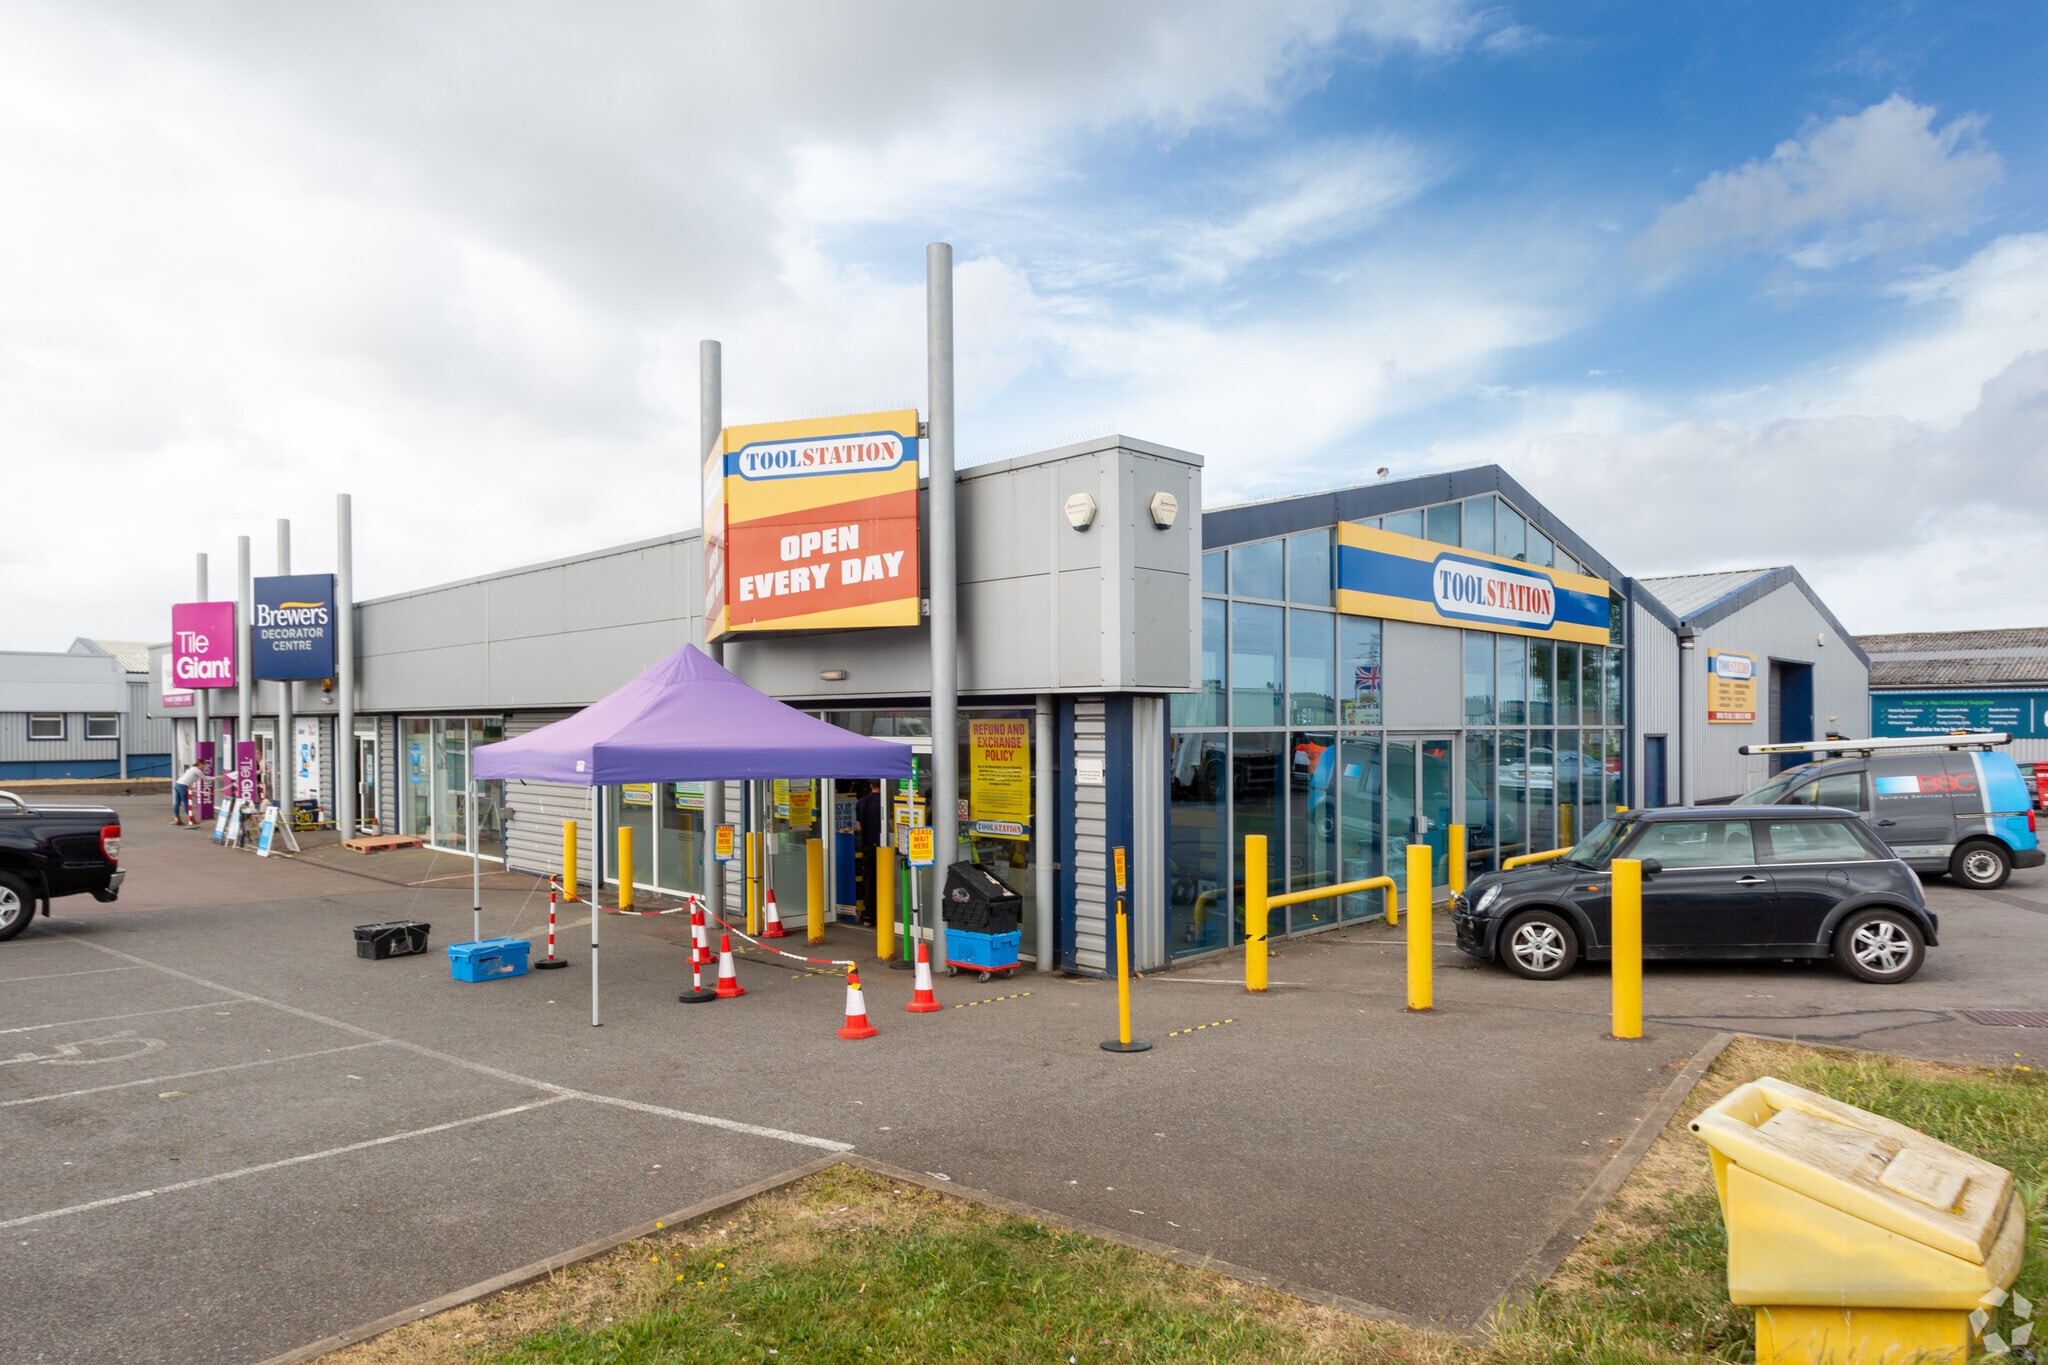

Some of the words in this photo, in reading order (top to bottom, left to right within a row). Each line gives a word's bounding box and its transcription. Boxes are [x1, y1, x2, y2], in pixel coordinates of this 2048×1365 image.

[746, 441, 896, 471] TOOLSTATION
[780, 523, 859, 562] OPEN
[739, 562, 831, 602] EVERY
[841, 550, 905, 586] DAY
[1439, 569, 1551, 616] TOOLSTATION
[256, 604, 329, 627] Brewers
[176, 631, 209, 654] Tile
[261, 627, 324, 639] DECORATOR
[272, 640, 312, 651] CENTRE
[176, 656, 231, 679] Giant
[1718, 659, 1750, 675] TOOLSTATION
[973, 723, 1005, 736] REFUND
[1008, 723, 1025, 736] AND
[977, 736, 1022, 749] EXCHANGE
[985, 749, 1014, 762] POLICY
[240, 758, 253, 778] Tile
[241, 779, 254, 801] Gia
[1916, 773, 1976, 793] BSC
[910, 828, 932, 836] PLEASE
[978, 823, 1021, 833] TOOLSTATION
